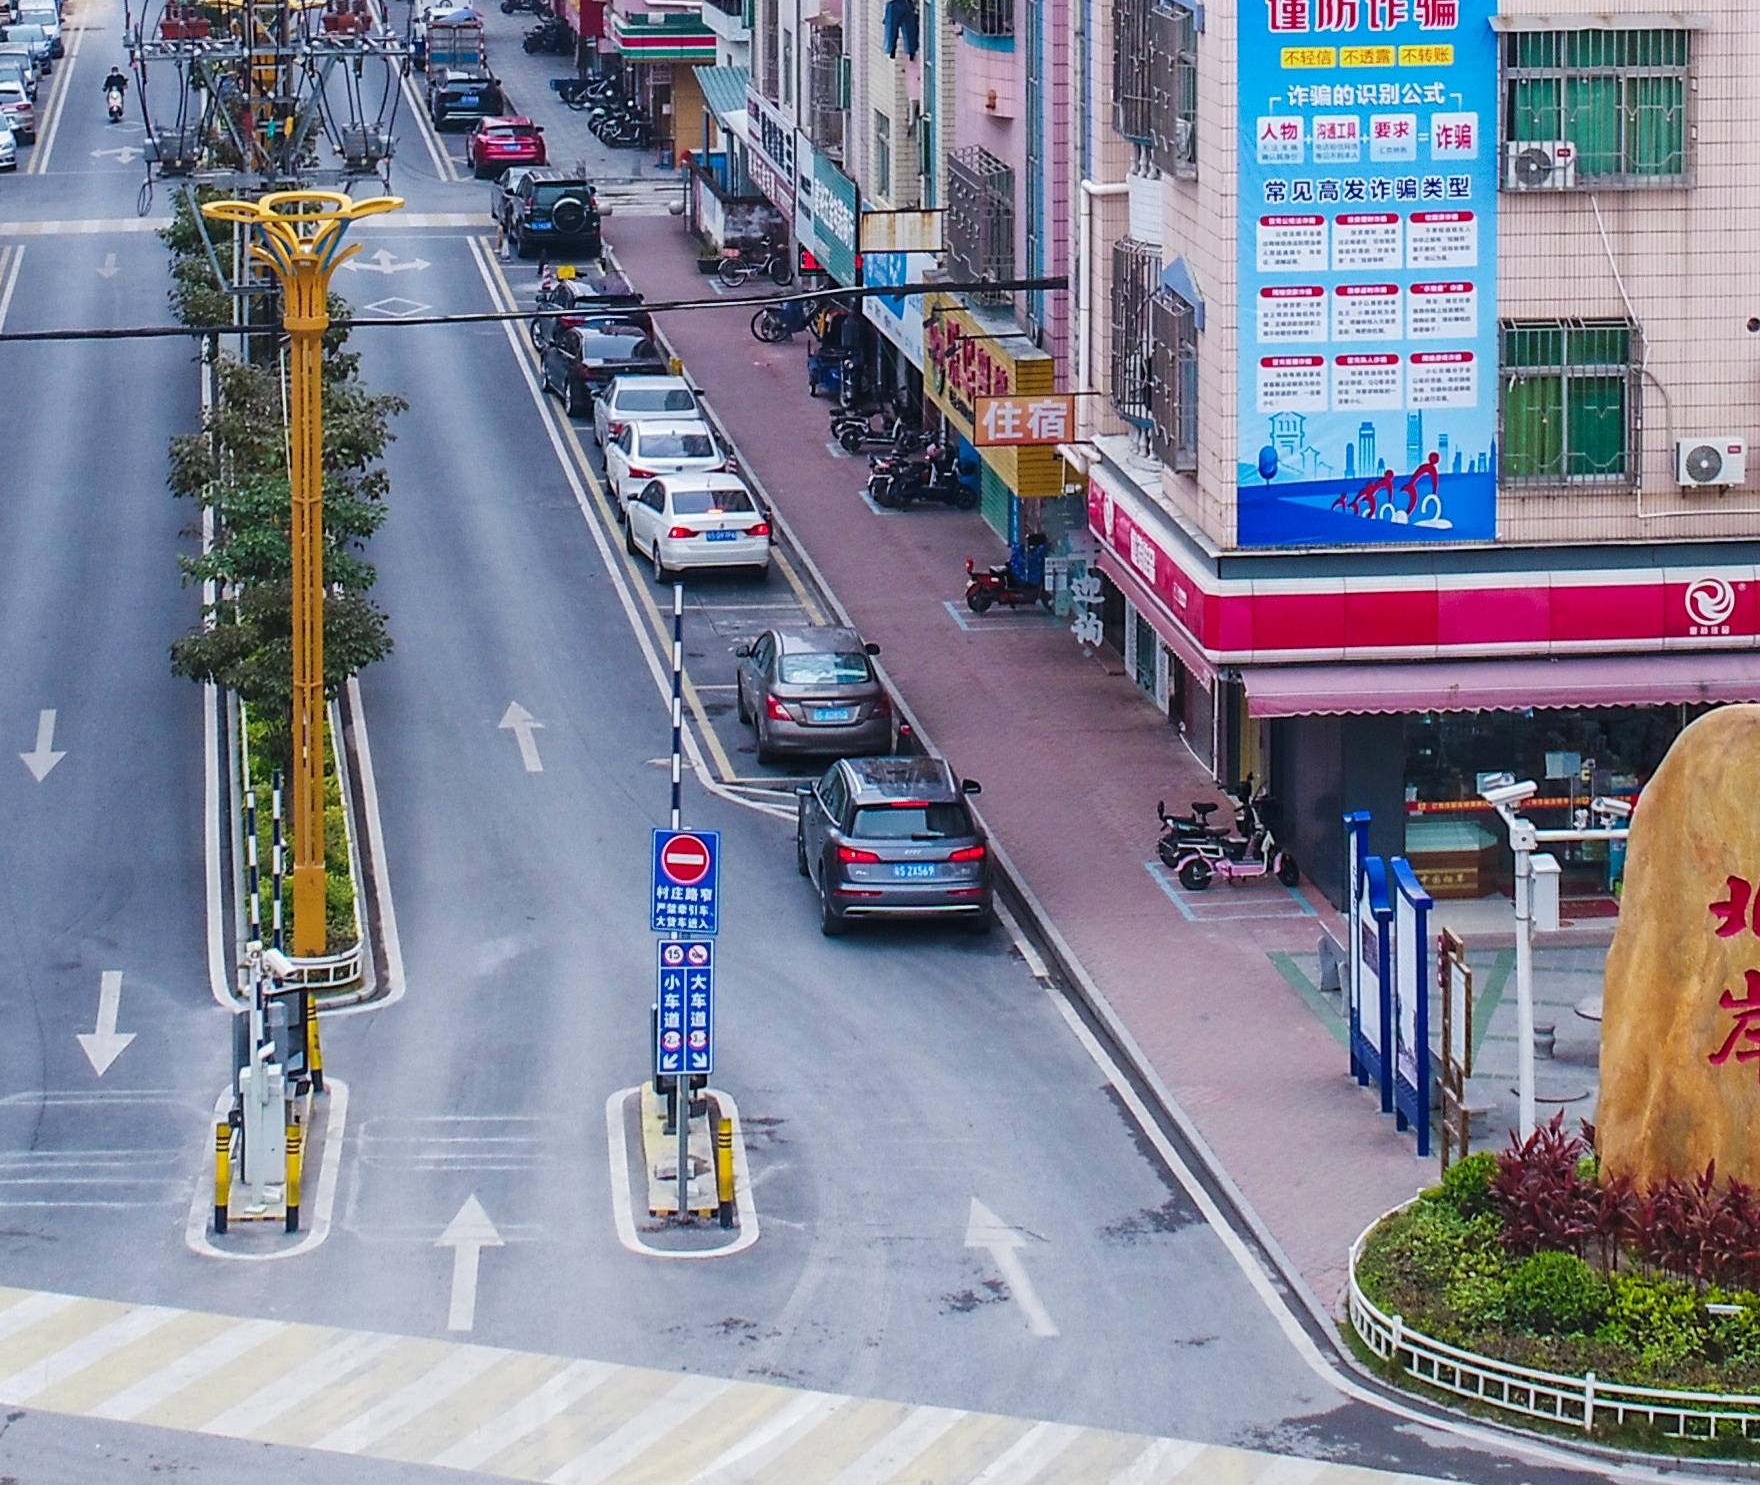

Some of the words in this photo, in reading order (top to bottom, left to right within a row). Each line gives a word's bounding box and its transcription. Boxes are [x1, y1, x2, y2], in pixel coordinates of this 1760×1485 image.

[1283, 49, 1332, 66] 不轻信
[1342, 48, 1391, 65] 不透露
[1401, 47, 1450, 64] 不转账
[1287, 82, 1446, 108] 诈骗的识别公式
[1261, 122, 1298, 141] 人物
[1316, 121, 1357, 140] 沟通工具
[1373, 120, 1410, 139] 要求
[1435, 124, 1472, 150] 诈骗
[1265, 176, 1472, 203] 常见高发诈骗类型
[981, 399, 1068, 441] 住宿
[668, 949, 681, 960] 15
[664, 973, 681, 1028] 小车道
[690, 973, 707, 1027] 大车道
